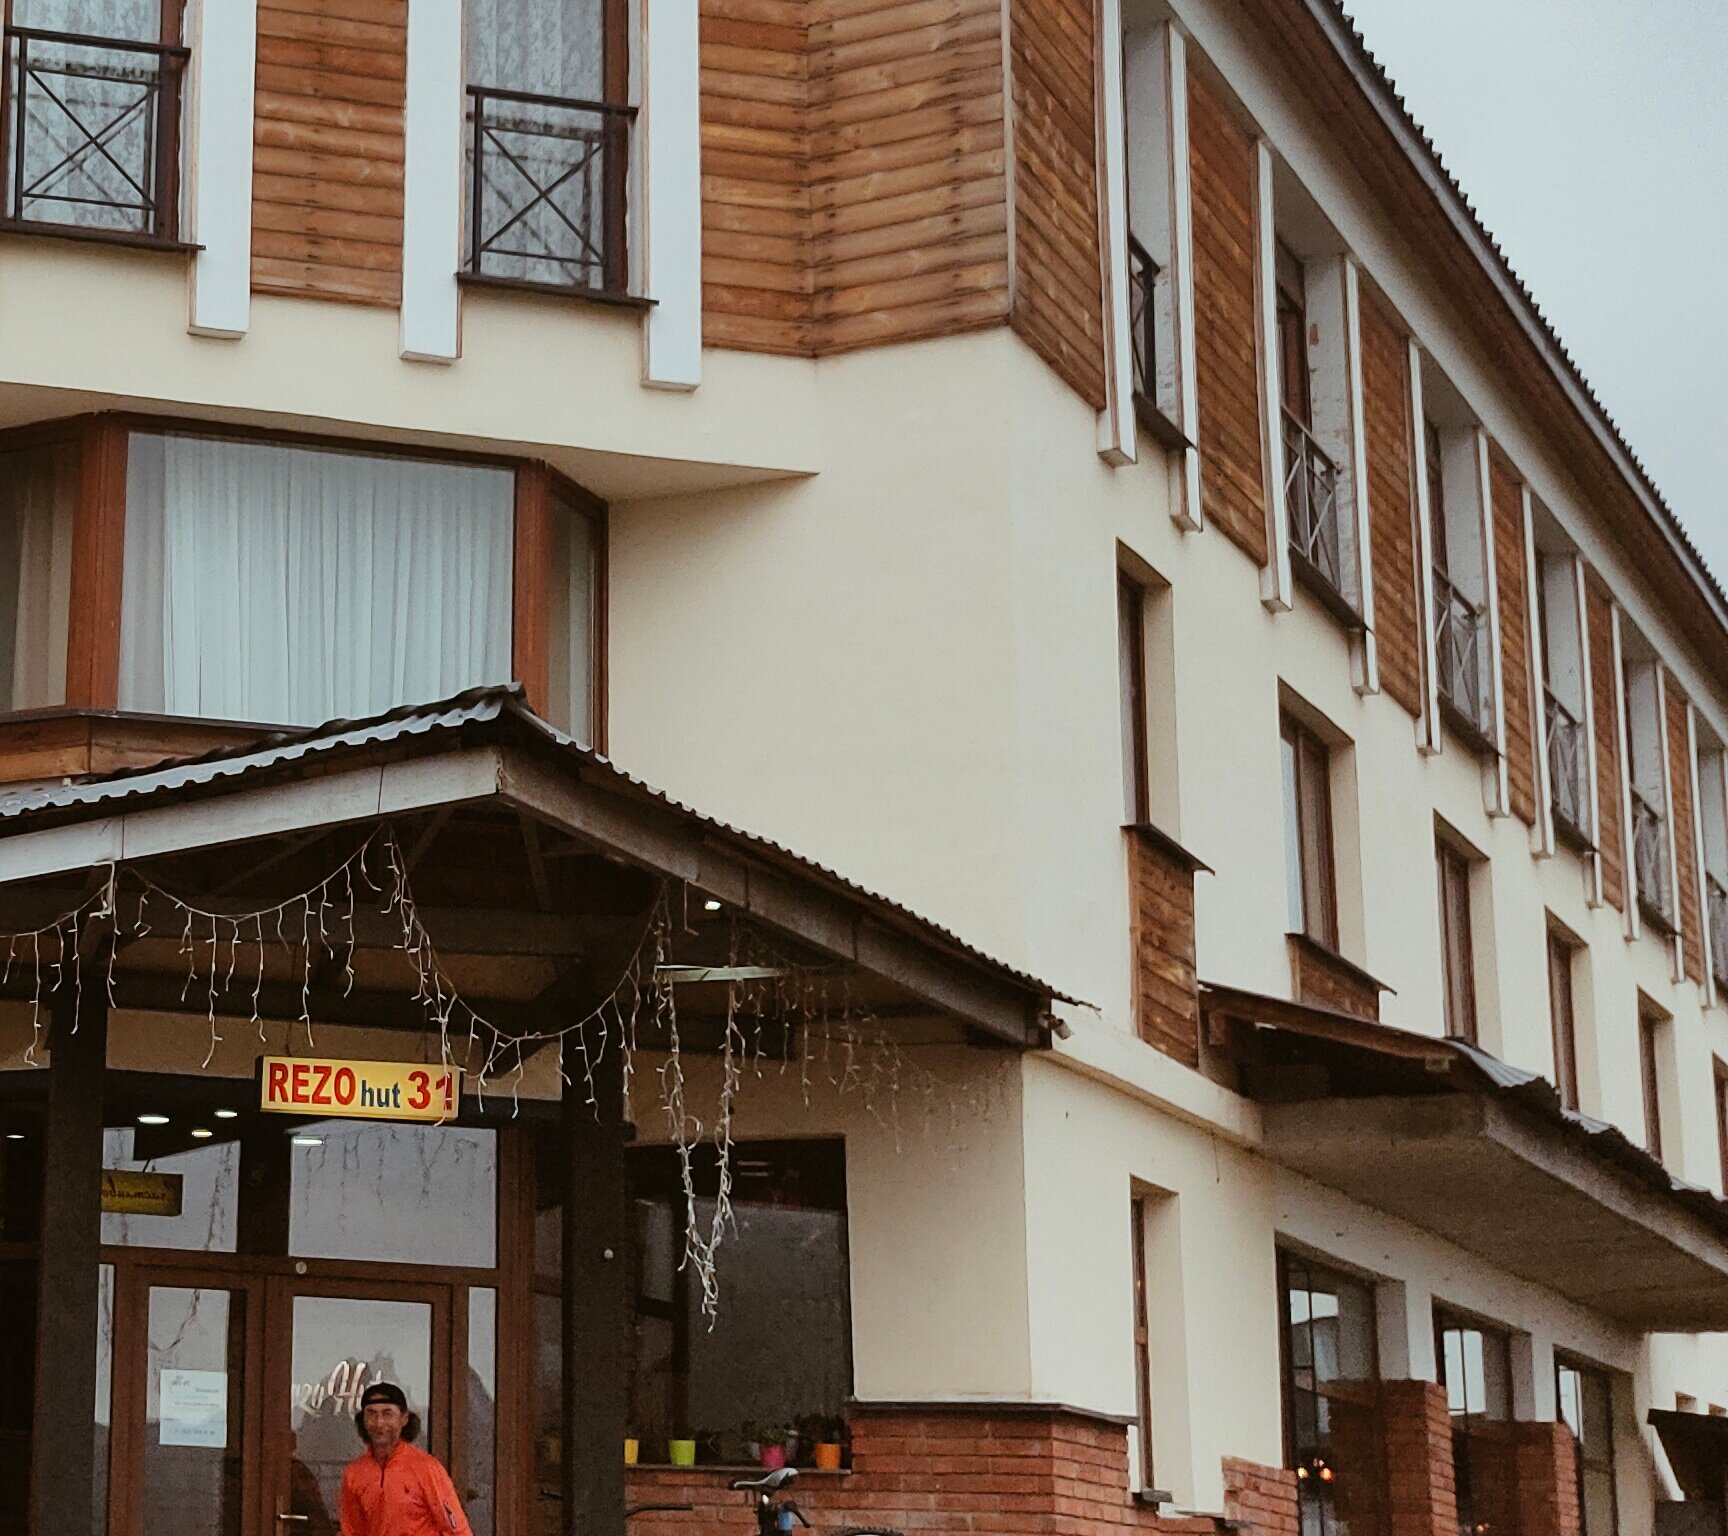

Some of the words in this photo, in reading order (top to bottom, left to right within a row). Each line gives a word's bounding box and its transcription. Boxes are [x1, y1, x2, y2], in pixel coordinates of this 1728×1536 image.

[268, 1062, 356, 1106] REZO
[361, 1079, 401, 1109] hut
[407, 1070, 453, 1112] 31
